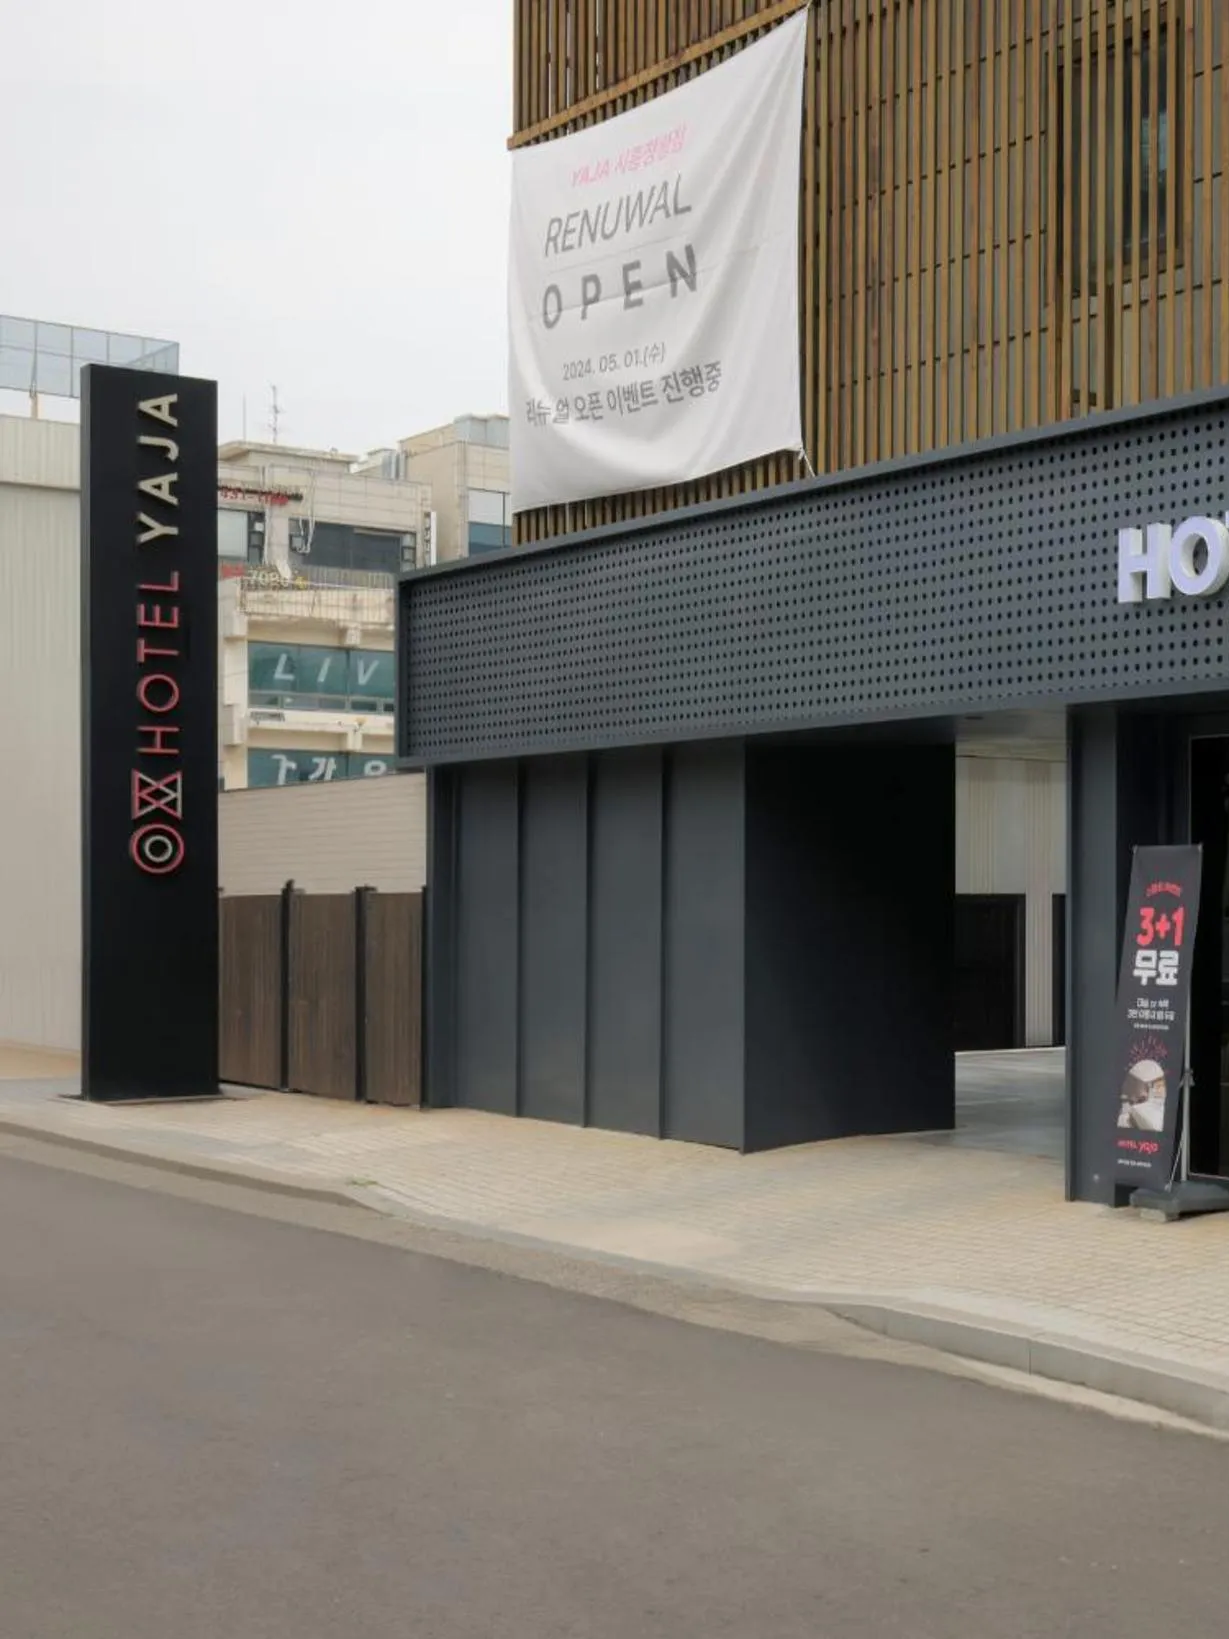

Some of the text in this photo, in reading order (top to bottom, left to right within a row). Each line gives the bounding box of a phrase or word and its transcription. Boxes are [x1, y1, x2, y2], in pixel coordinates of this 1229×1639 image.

[544, 173, 692, 258] RENUWAL
[542, 244, 699, 330] OPEN
[574, 391, 604, 421] 오픈
[606, 379, 659, 416] 이벤트
[661, 360, 722, 404] 진행중
[136, 392, 180, 754] HOTEL YAJA
[1136, 906, 1185, 946] 3+1
[1133, 949, 1180, 986] 무료
